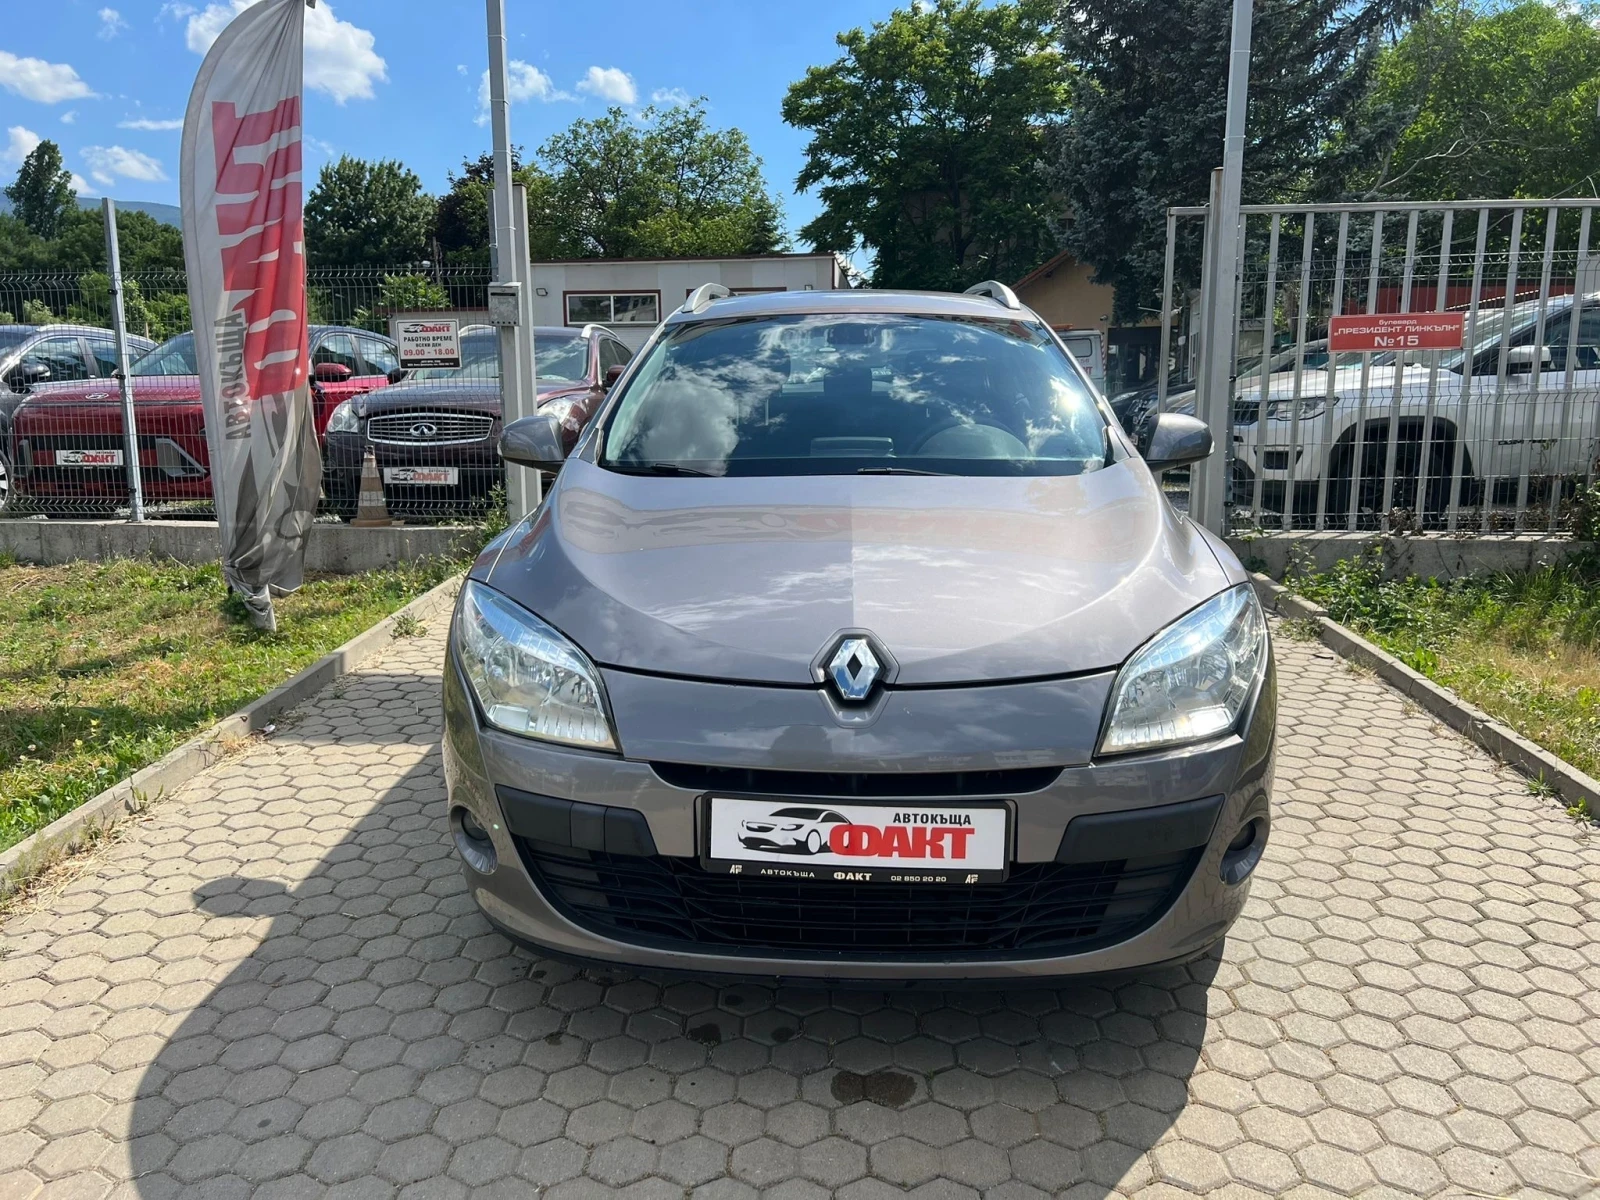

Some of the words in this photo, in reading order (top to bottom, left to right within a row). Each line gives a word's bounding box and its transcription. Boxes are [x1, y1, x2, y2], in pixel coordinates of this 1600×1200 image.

[213, 311, 252, 441] АВТОКЪЩА
[893, 813, 971, 826] АВТОКЪЩА
[829, 824, 975, 859] ФАКТ
[833, 871, 872, 881] ФАКТ
